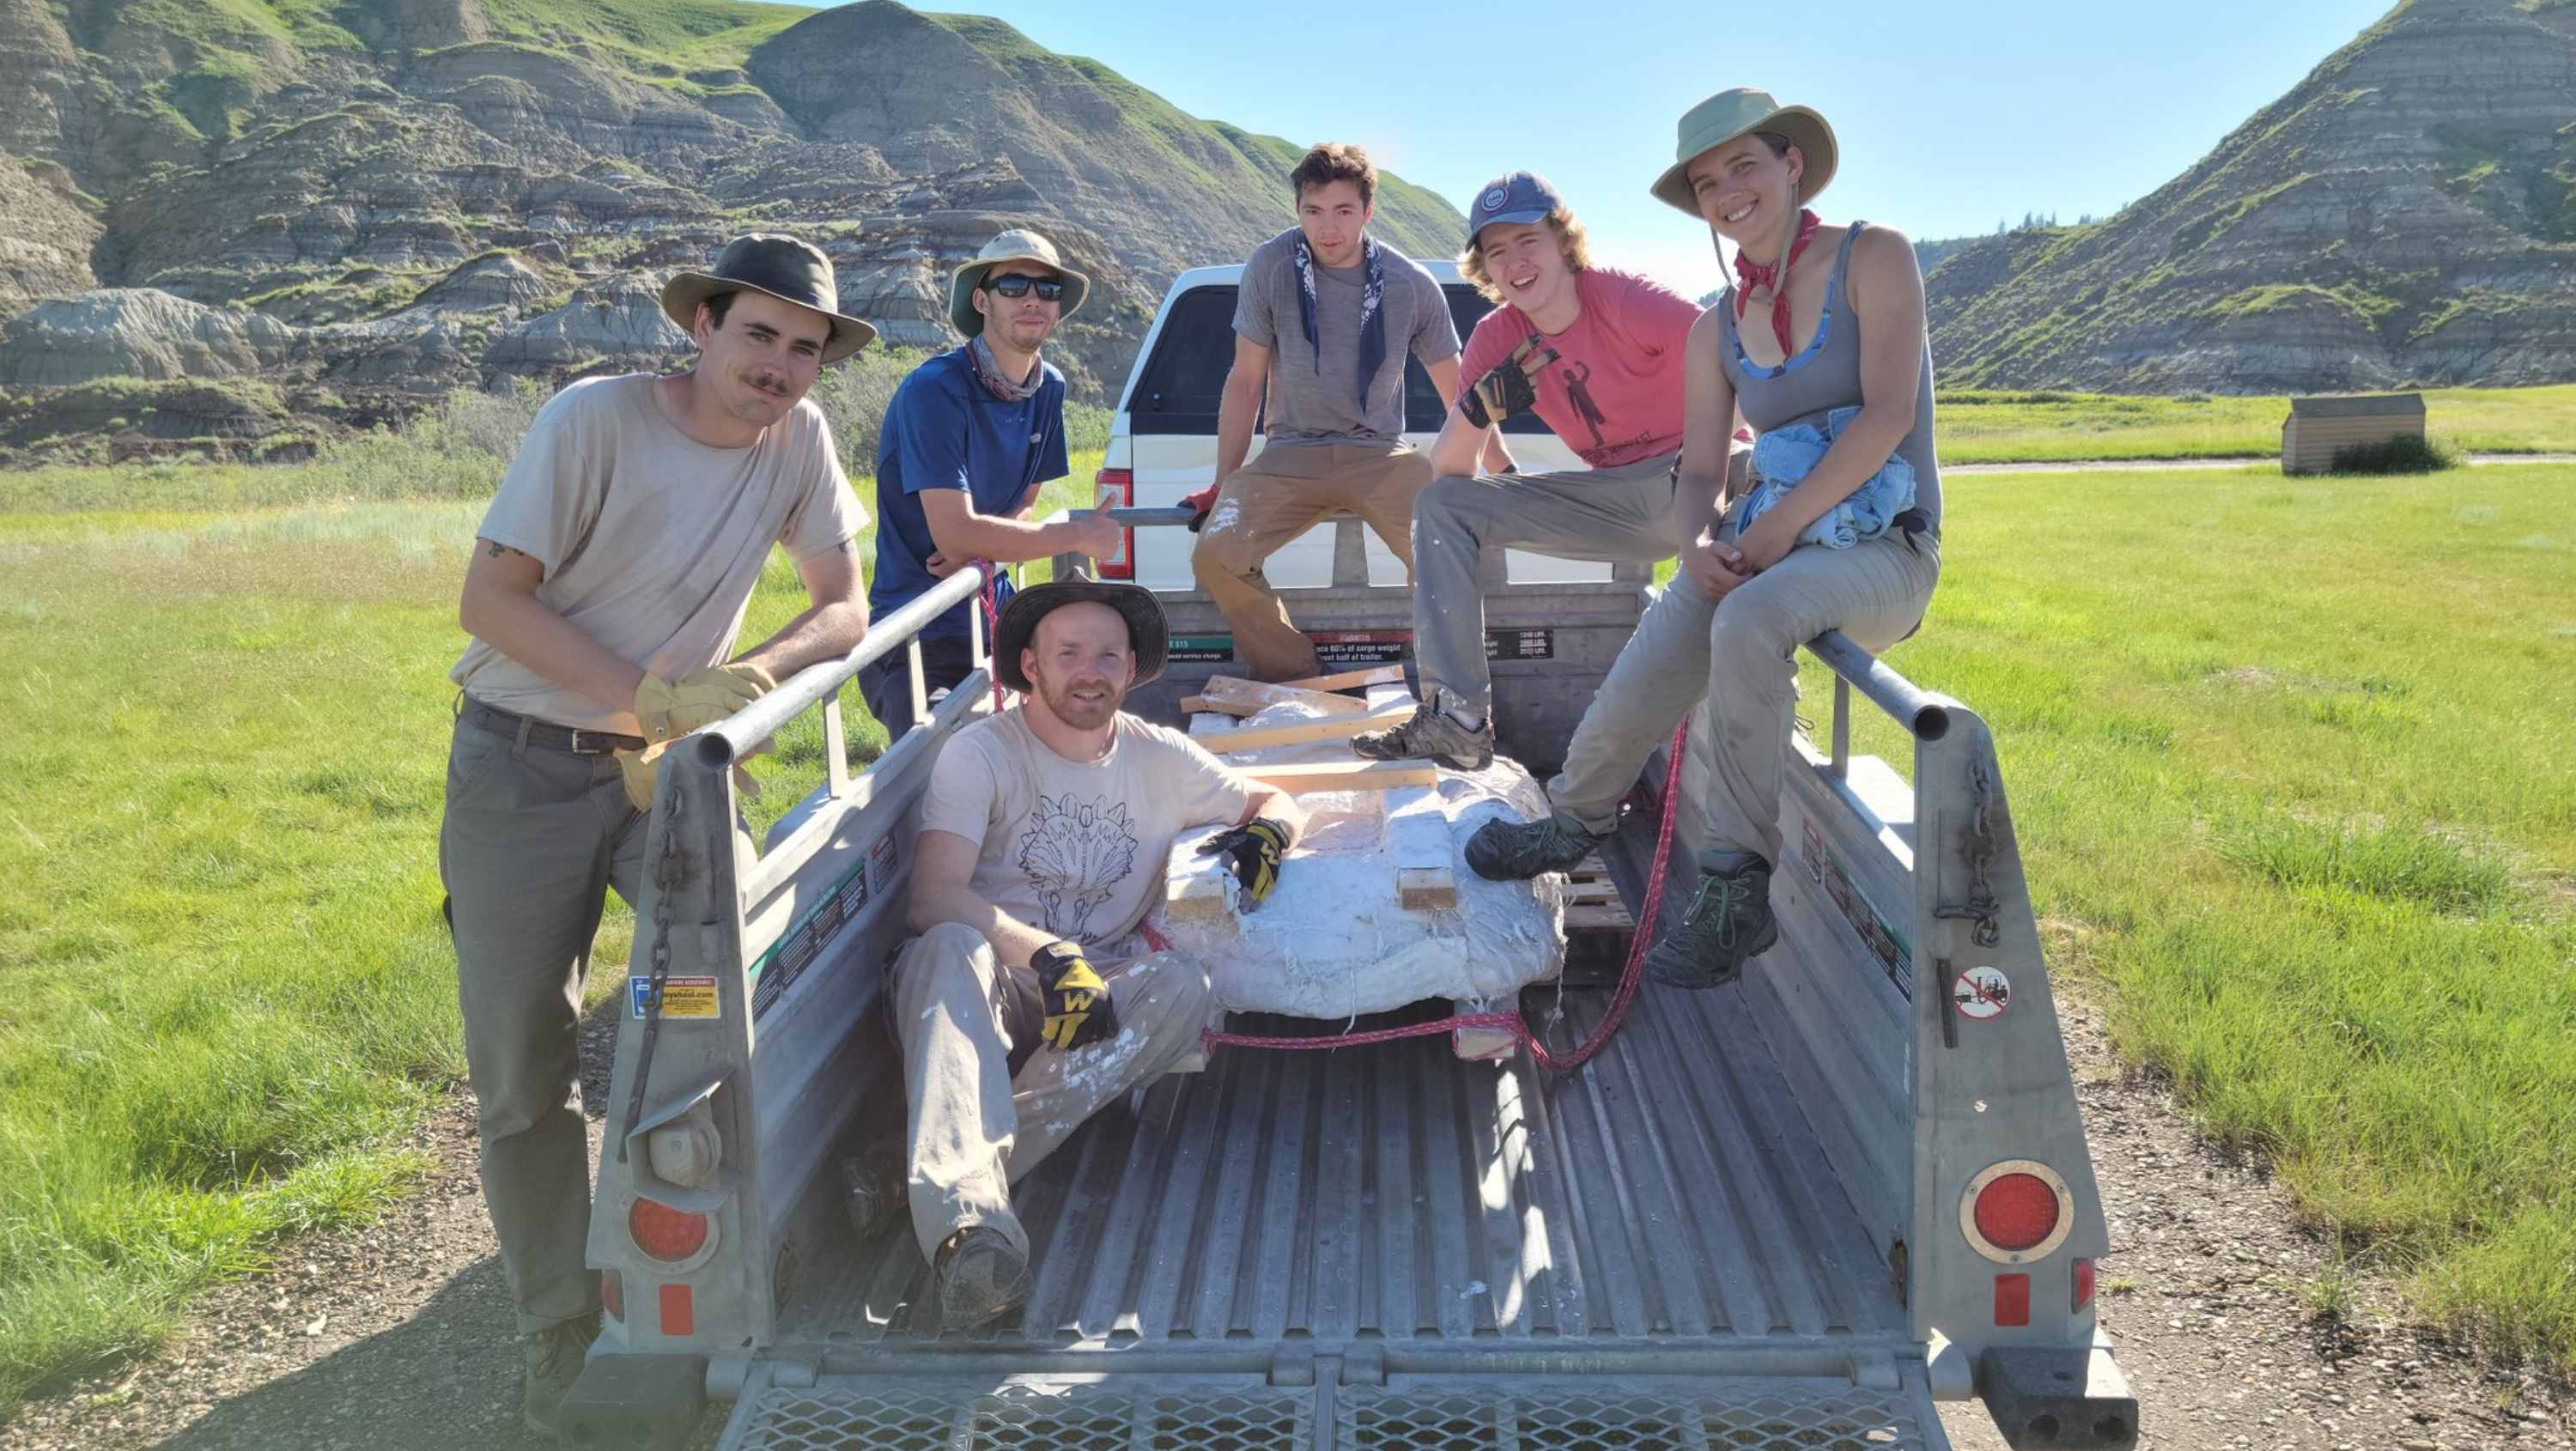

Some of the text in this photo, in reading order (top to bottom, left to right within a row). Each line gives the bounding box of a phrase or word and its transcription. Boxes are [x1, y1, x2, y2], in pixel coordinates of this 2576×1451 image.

[1347, 644, 1356, 653] of
[1357, 645, 1376, 653] cargo
[1377, 644, 1400, 653] weight
[1335, 653, 1351, 661] half
